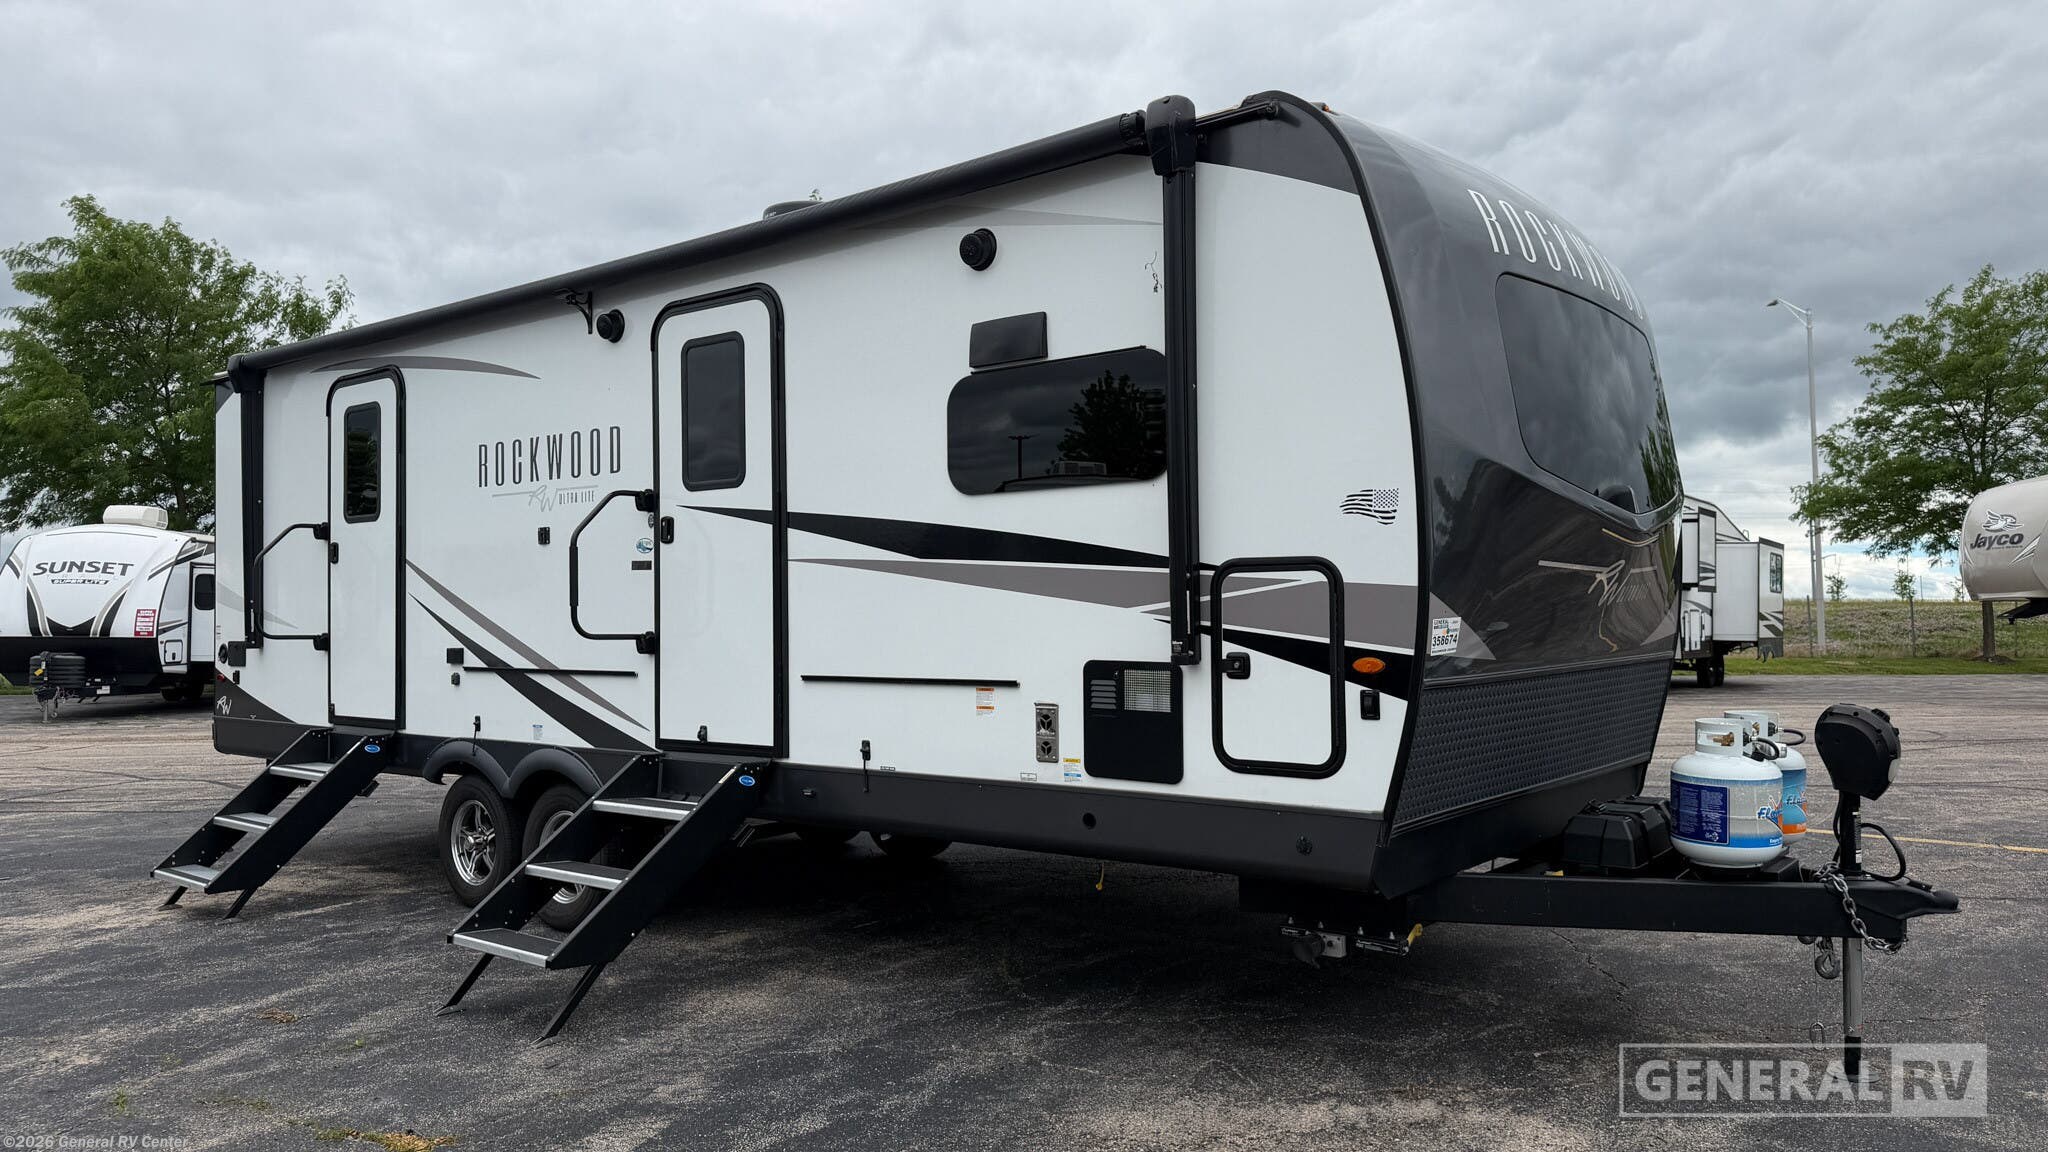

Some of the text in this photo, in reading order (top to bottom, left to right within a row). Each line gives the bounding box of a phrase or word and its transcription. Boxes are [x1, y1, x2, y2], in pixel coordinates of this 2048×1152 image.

[478, 426, 621, 488] ROCKWOOD
[1970, 533, 2024, 550] Jayco
[33, 561, 134, 576] SUNSET
